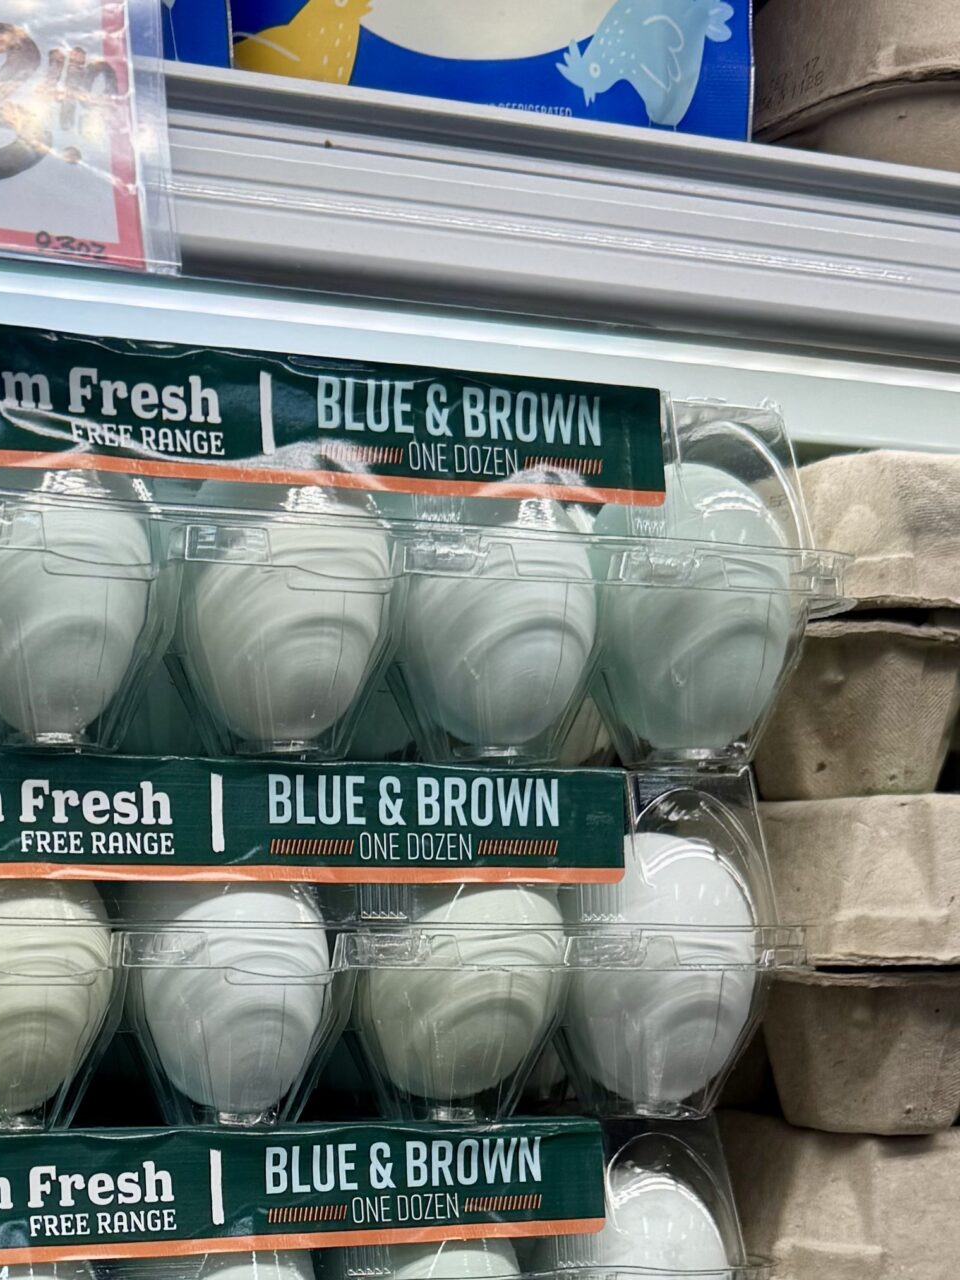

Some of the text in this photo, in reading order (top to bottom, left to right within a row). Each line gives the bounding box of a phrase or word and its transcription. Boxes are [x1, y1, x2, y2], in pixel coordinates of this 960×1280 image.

[68, 366, 222, 424] Fresh
[317, 375, 603, 448] BLUE & BROWN
[71, 421, 226, 456] FREE RANGE
[408, 441, 520, 477] ONE DOZEN
[19, 778, 174, 826] Fresh
[268, 774, 560, 827] BLUE & BROWN
[20, 830, 175, 856] FREE RANGE
[359, 832, 473, 861] ONE DOZEN
[28, 1160, 175, 1210] Fresh
[265, 1136, 542, 1194] BLUE & BROWN
[29, 1209, 177, 1237] FREE RANGE
[352, 1192, 460, 1224] ONE DOZEN
